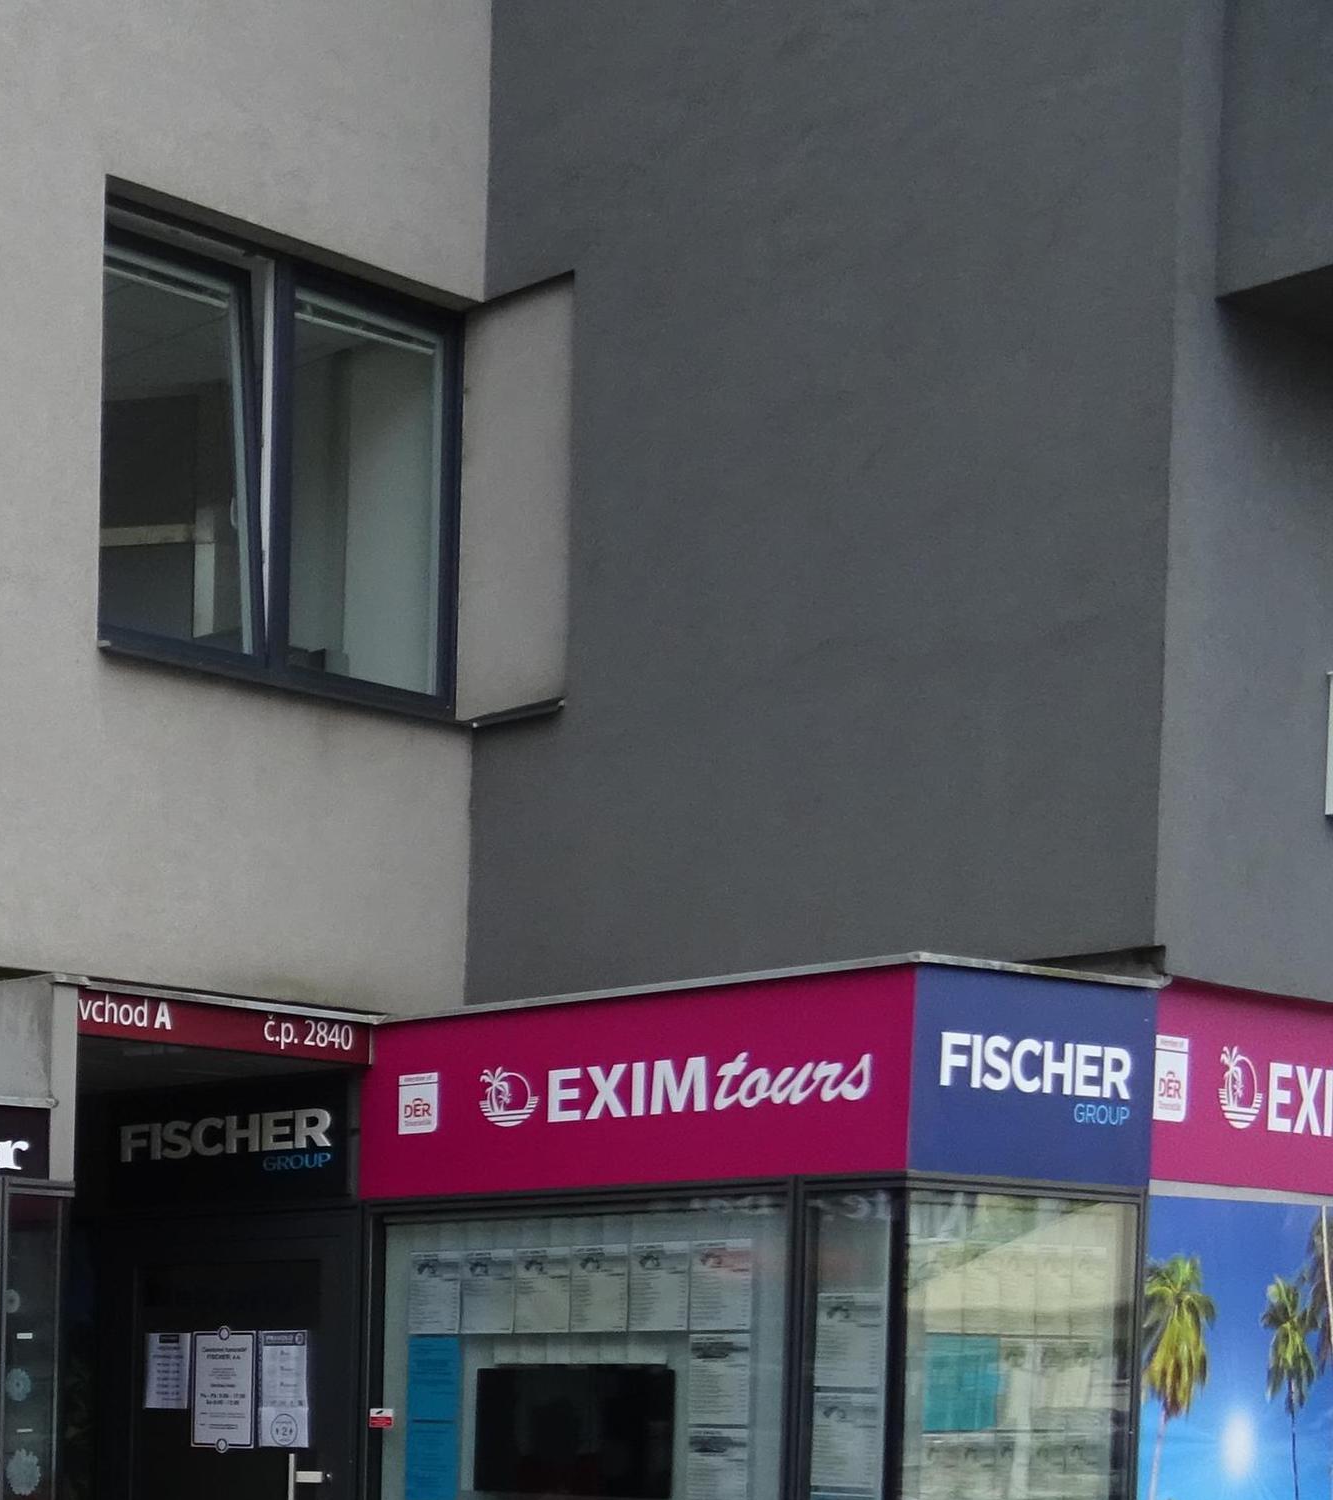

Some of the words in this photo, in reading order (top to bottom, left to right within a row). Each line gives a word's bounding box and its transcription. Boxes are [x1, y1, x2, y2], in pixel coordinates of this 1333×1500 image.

[78, 993, 148, 1028] vchod
[153, 1000, 172, 1031] A
[303, 1019, 353, 1051] 2840
[939, 1031, 1132, 1100] FISCHER
[403, 1102, 432, 1119] DER
[1073, 1100, 1131, 1126] GROUP
[120, 1108, 332, 1163] FISCHER
[262, 1152, 332, 1172] GROUP
